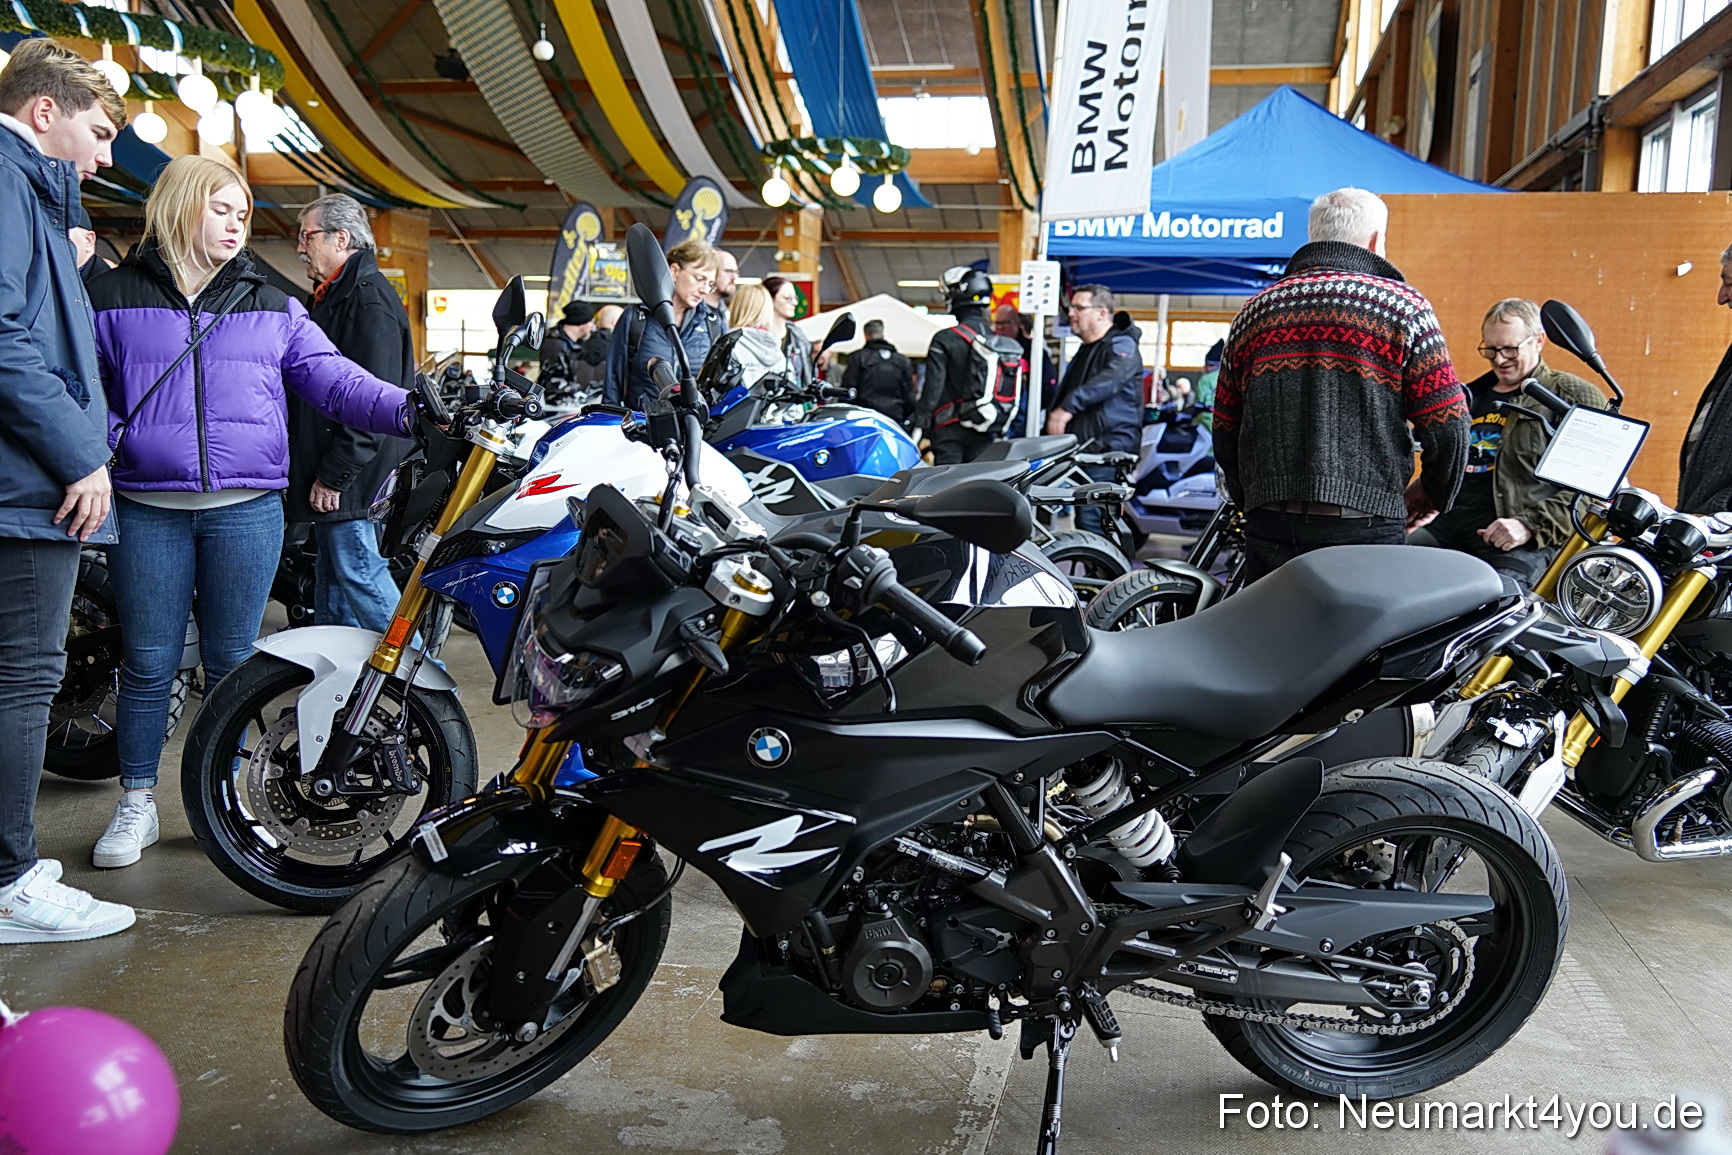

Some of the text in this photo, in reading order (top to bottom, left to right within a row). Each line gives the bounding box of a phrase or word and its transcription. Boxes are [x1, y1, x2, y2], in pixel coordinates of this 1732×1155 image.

[1071, 40, 1107, 174] BMW
[1055, 211, 1283, 238] BMW Motorrad
[610, 697, 656, 721] 310
[388, 749, 403, 782] brembo
[865, 925, 893, 940] BMW
[1280, 1063, 1331, 1090] MICHELIN
